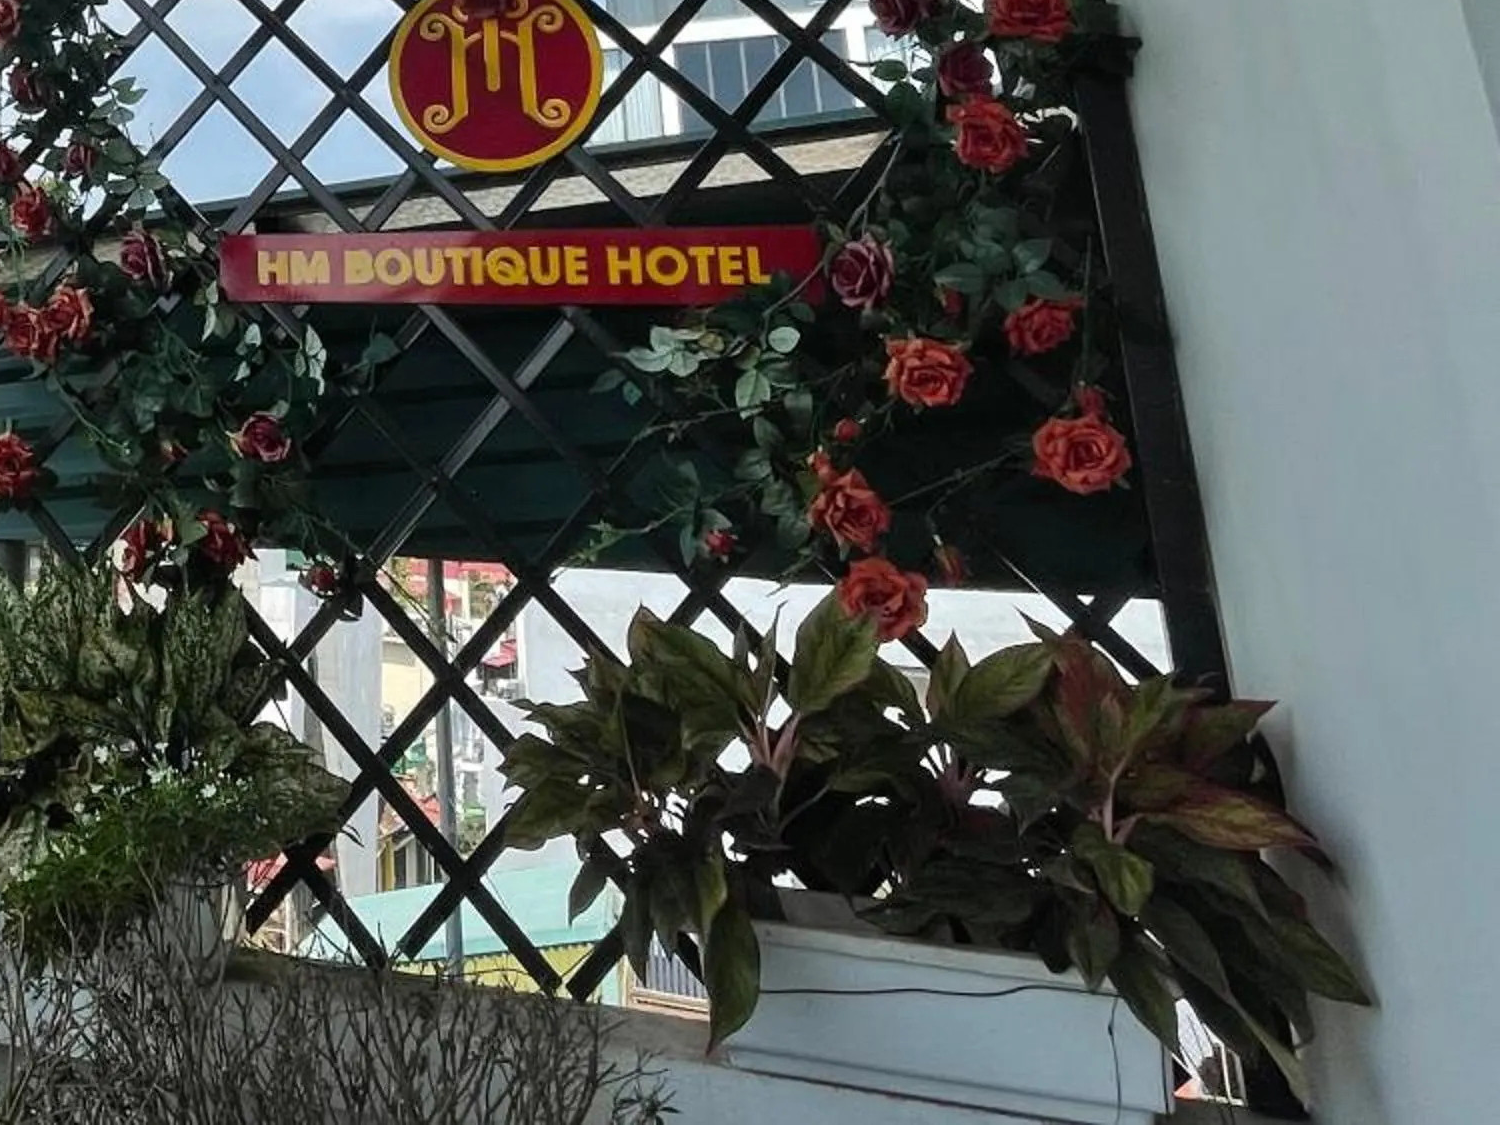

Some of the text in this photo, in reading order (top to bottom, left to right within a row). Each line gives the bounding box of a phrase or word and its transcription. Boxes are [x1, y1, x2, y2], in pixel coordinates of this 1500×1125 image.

[256, 244, 773, 287] HM BOUTIQUE HOTEL
